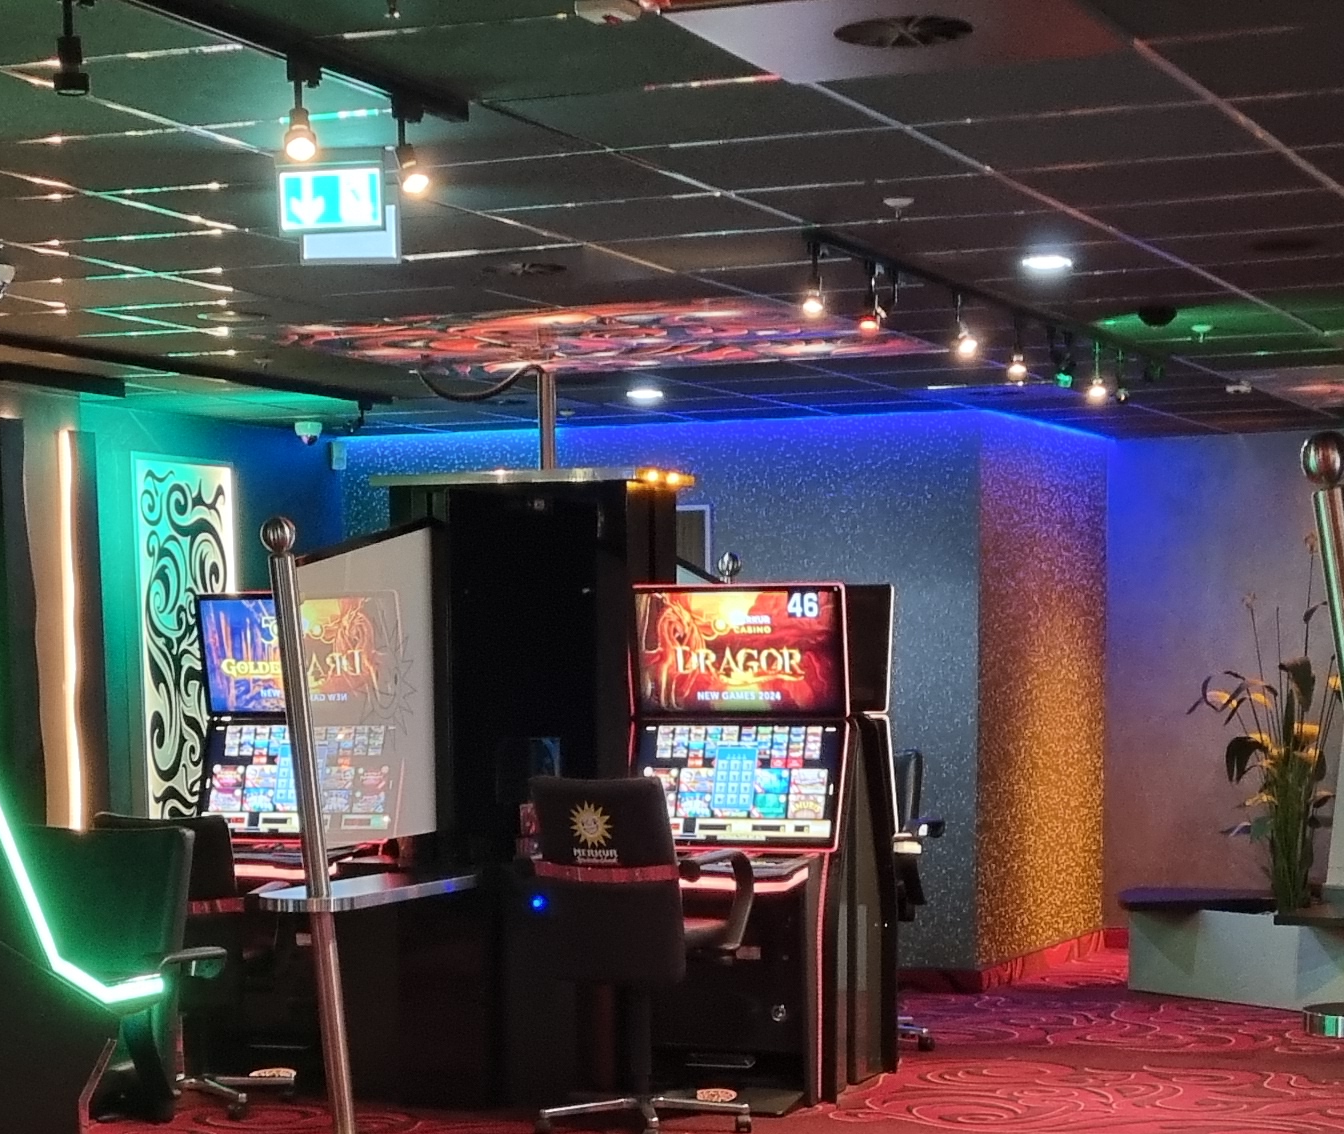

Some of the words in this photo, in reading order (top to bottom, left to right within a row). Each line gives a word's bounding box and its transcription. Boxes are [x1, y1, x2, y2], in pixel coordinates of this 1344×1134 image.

[787, 592, 820, 618] 46
[733, 625, 772, 634] CASINO
[672, 646, 805, 675] DRAGOR
[260, 688, 281, 698] NEW
[696, 691, 720, 700] NEW
[721, 691, 756, 700] GAMES
[758, 691, 782, 701] 2024
